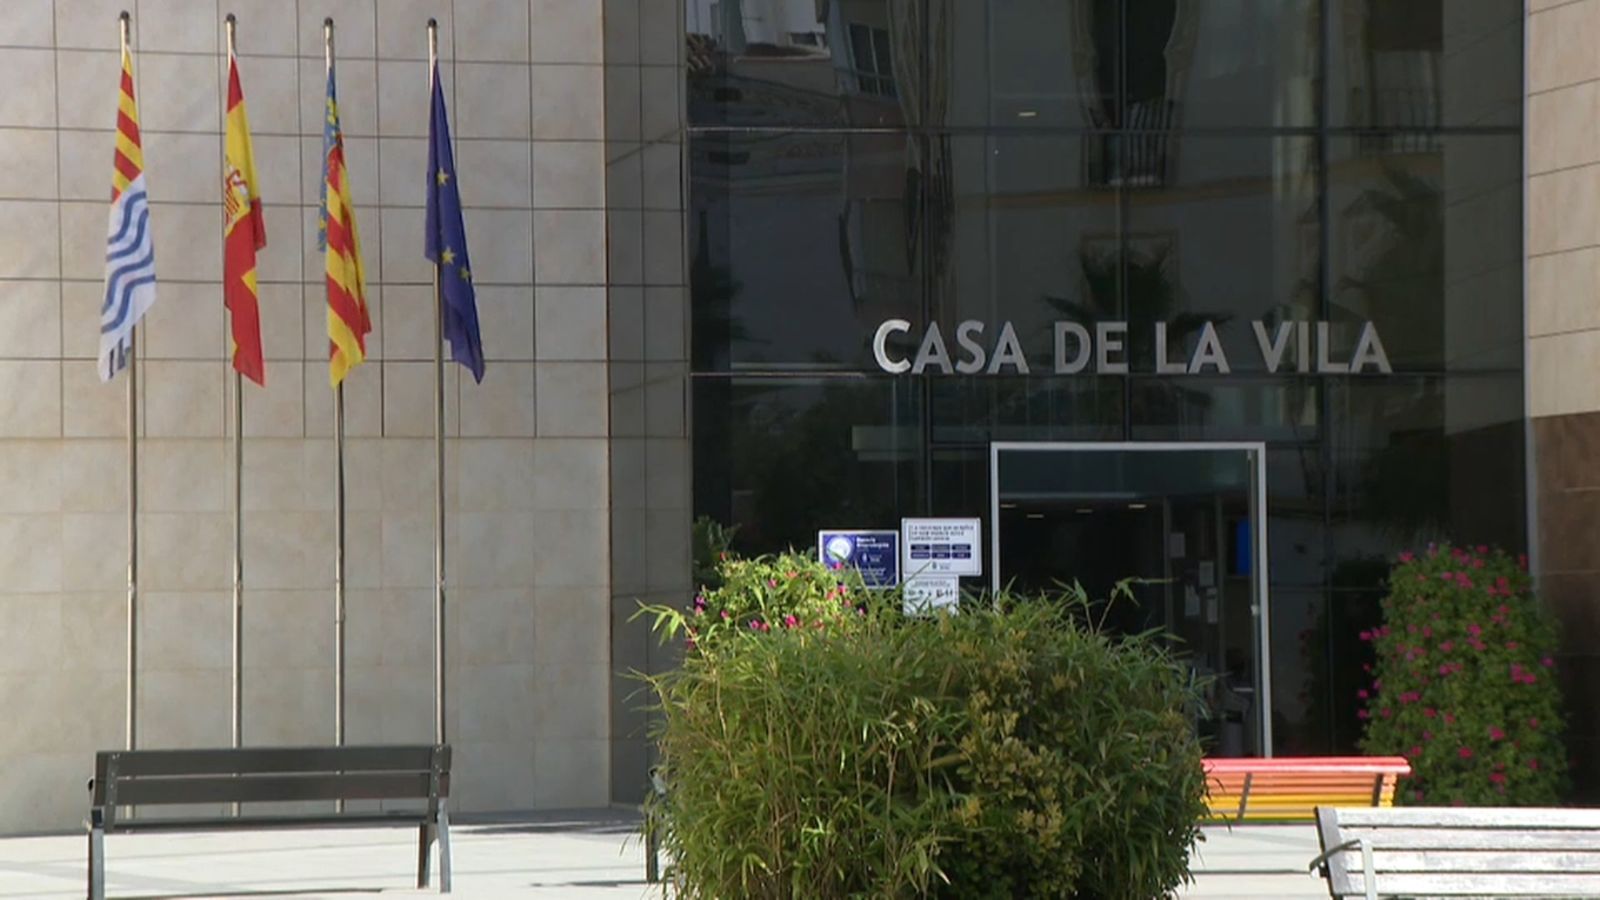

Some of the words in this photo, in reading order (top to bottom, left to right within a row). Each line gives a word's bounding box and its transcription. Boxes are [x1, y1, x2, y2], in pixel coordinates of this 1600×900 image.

[873, 319, 1030, 374] CASA
[1054, 321, 1129, 374] DE
[1155, 321, 1231, 374] LA
[1252, 321, 1393, 374] VILA
